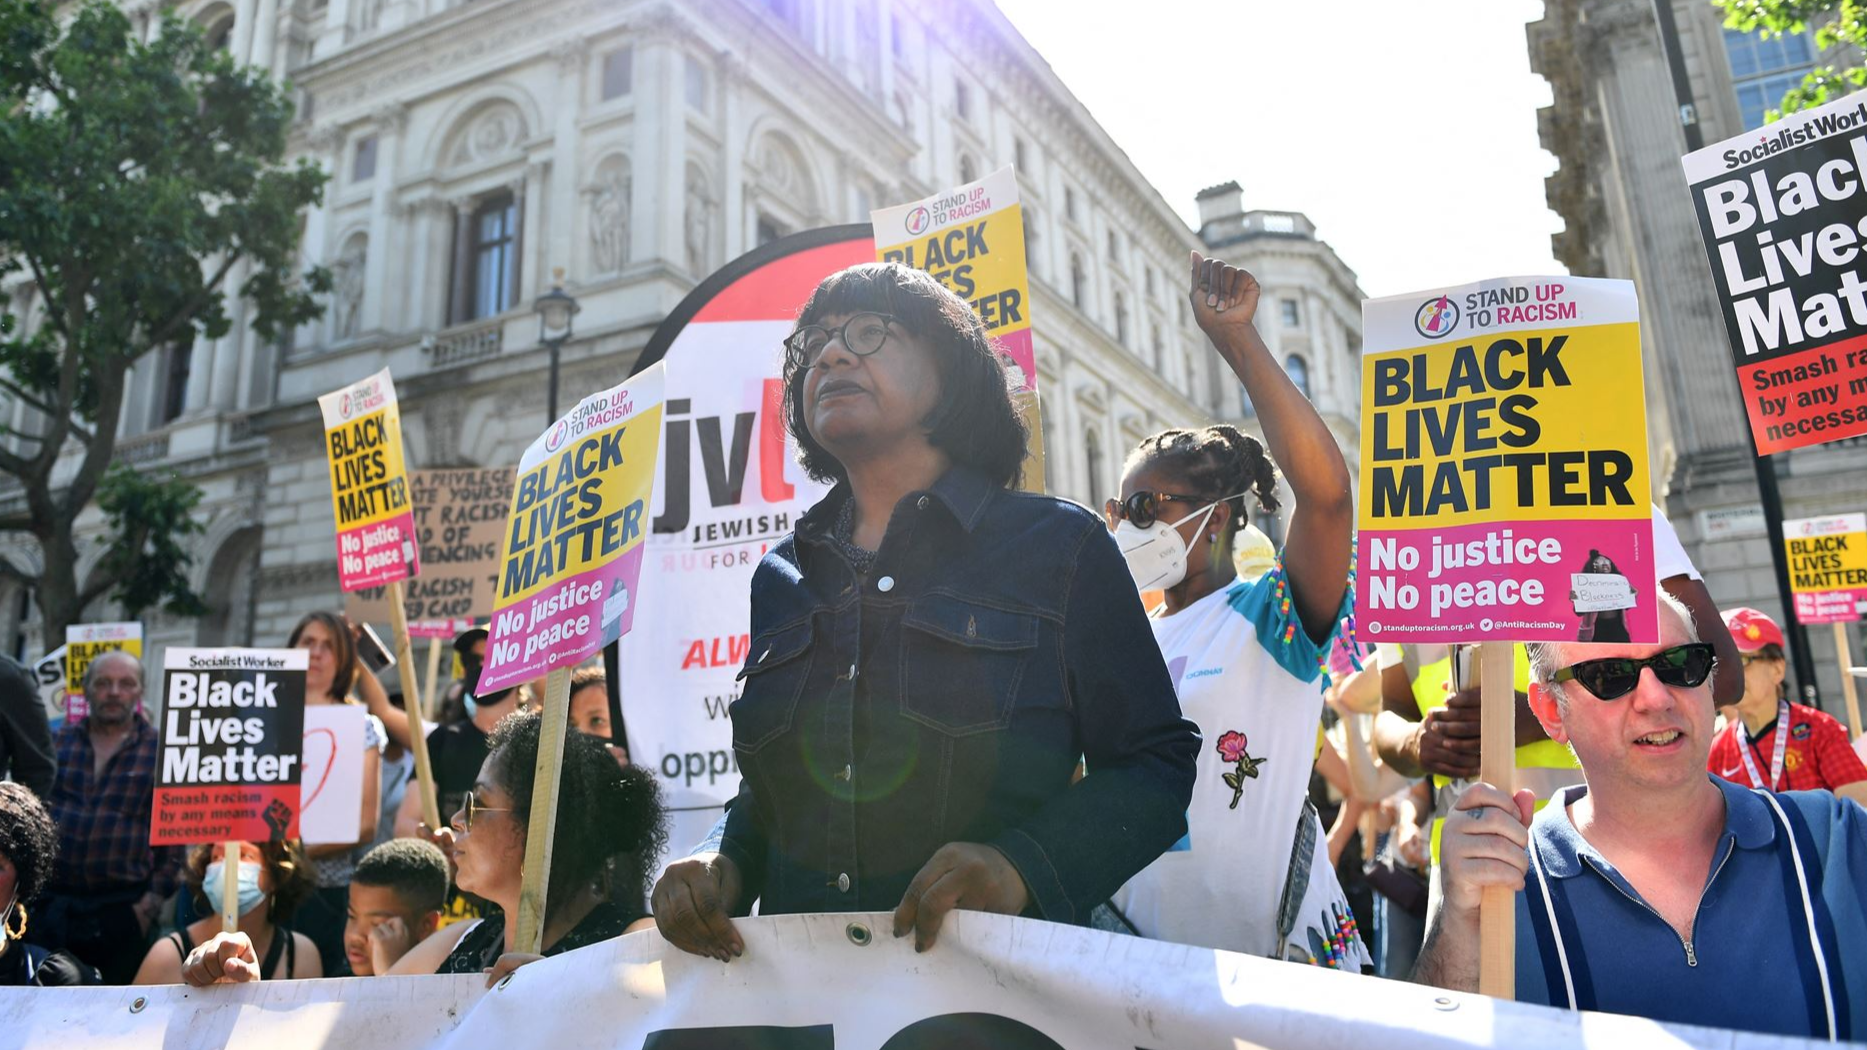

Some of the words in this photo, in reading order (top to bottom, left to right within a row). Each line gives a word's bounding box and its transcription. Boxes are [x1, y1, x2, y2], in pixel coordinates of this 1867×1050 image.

[933, 193, 966, 214] STAND
[969, 187, 985, 203] UP
[933, 213, 947, 227] TO
[949, 197, 991, 221] RACISM
[1718, 213, 1867, 296] Live
[1466, 286, 1529, 311] STAND
[1535, 283, 1565, 302] UP
[1733, 270, 1867, 355] Mat
[1466, 310, 1491, 329] TO
[1497, 302, 1577, 326] RACISM
[1373, 334, 1572, 407] BLACK
[1752, 354, 1838, 391] Smash
[571, 398, 608, 425] STAND
[611, 390, 629, 407] UP
[571, 424, 584, 438] TO
[586, 400, 633, 430] RACISM
[1758, 395, 1787, 418] by
[1796, 384, 1839, 408] any
[330, 413, 388, 460] BLACK
[1372, 393, 1541, 462] LIVES
[1766, 405, 1867, 441] necessa
[334, 450, 386, 492] LIVES
[516, 426, 626, 514] BLACK
[653, 378, 795, 534] jvl
[337, 476, 407, 525] MATTER
[450, 487, 512, 501] YOURSE
[1371, 449, 1635, 518] MATTER
[509, 478, 603, 555] LIVES
[693, 512, 789, 544] JEWISH
[341, 533, 361, 554] No
[361, 525, 400, 557] justice
[502, 498, 644, 599] MATTER
[1369, 537, 1420, 571] No
[1428, 529, 1562, 579] justice
[1790, 536, 1848, 555] BLACK
[342, 555, 362, 576] No
[364, 547, 400, 576] peace
[711, 551, 749, 569] FOR
[1793, 553, 1842, 572] LIVES
[1795, 568, 1867, 588] MATTER
[495, 609, 524, 640] No
[526, 579, 603, 634] justice
[1368, 575, 1420, 610] No
[1430, 577, 1544, 618] peace
[490, 640, 520, 670] No
[523, 614, 590, 664] peace
[1383, 622, 1474, 632] standuptoracism.org.uk
[1494, 621, 1565, 631] @AntiRacismDay
[681, 634, 750, 671] ALW
[168, 672, 278, 708] Black
[165, 709, 264, 745] Lives
[162, 746, 297, 784] Matter
[159, 807, 176, 822] by
[181, 809, 206, 822] any
[211, 808, 257, 819] means
[161, 792, 209, 806] Smash
[213, 792, 262, 804] racism
[158, 824, 232, 838] necessary
